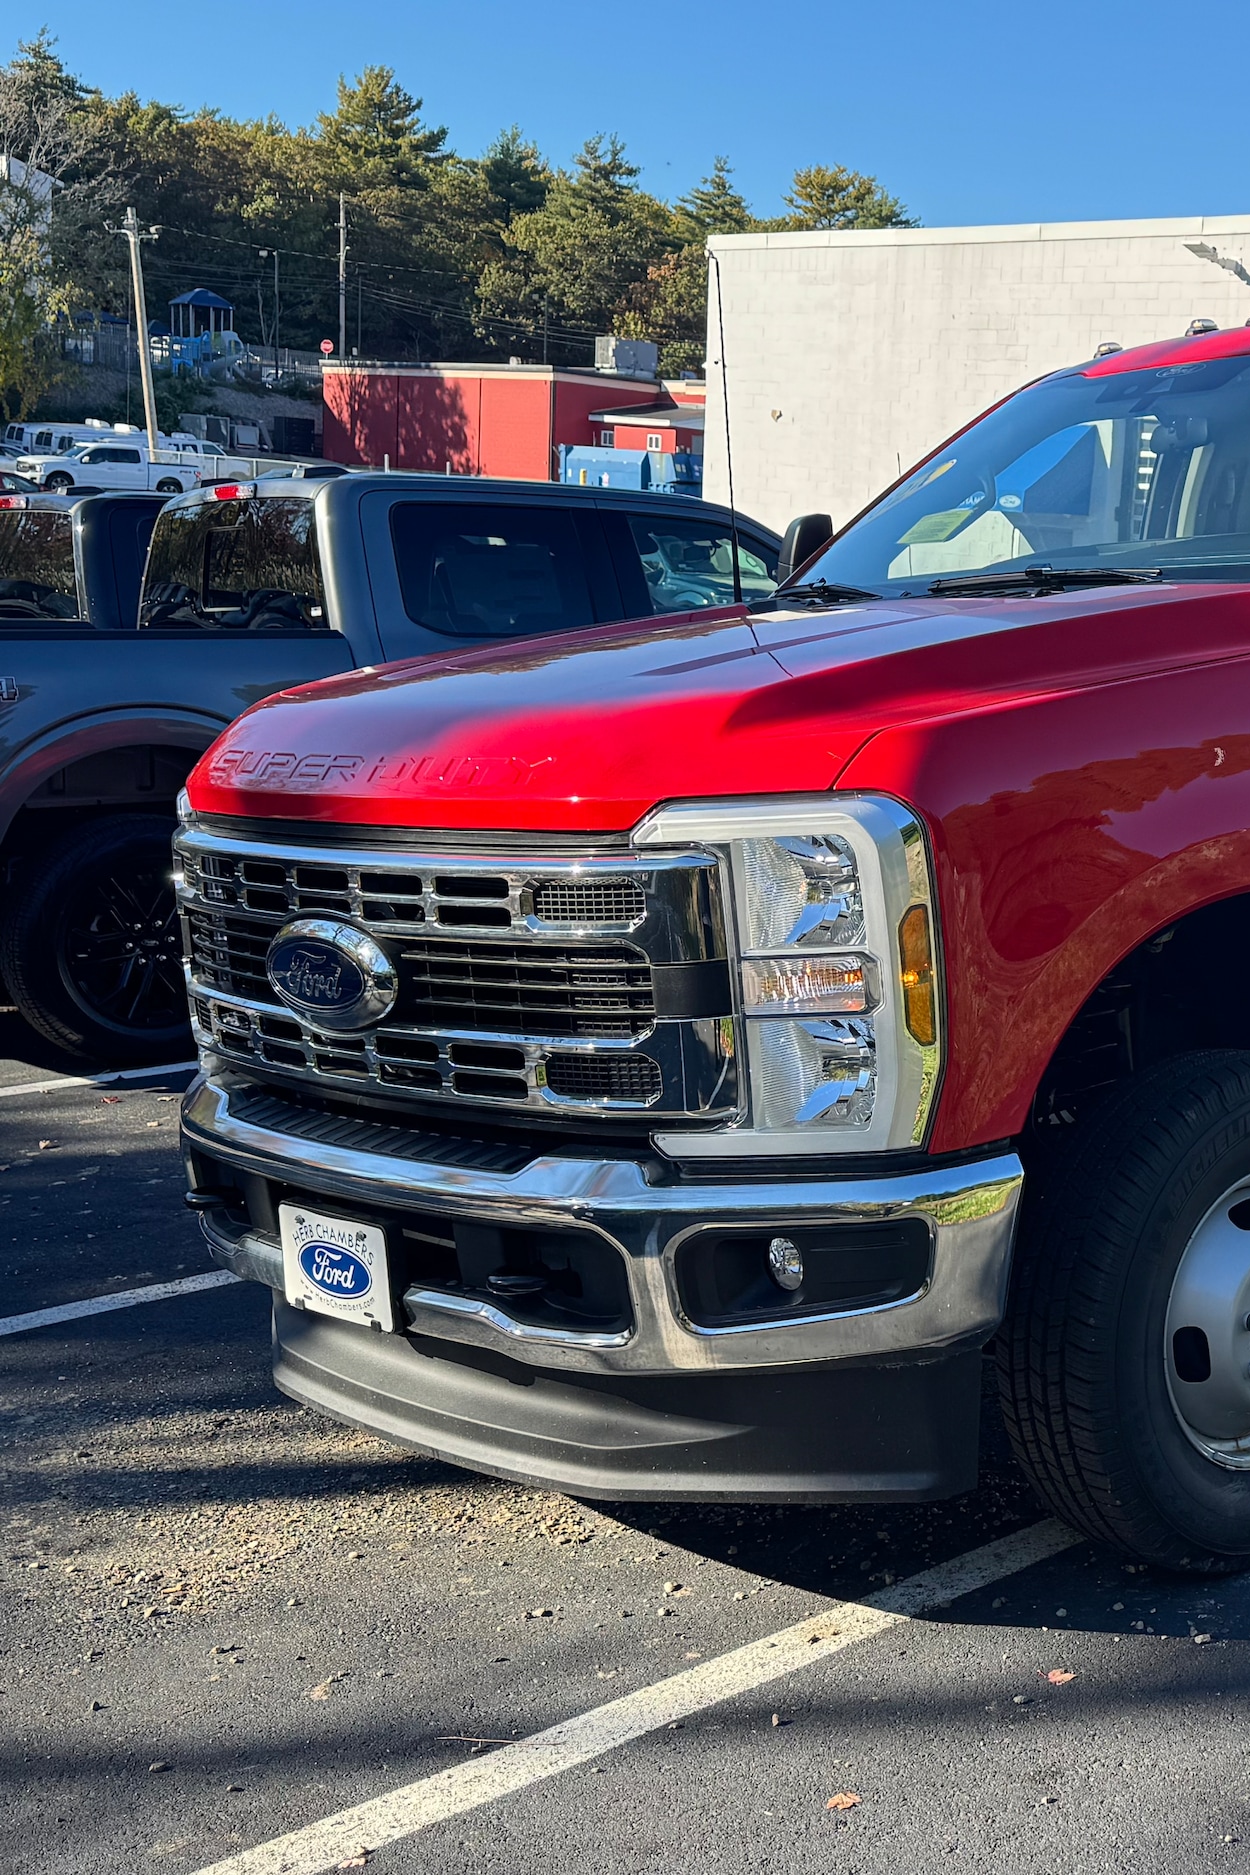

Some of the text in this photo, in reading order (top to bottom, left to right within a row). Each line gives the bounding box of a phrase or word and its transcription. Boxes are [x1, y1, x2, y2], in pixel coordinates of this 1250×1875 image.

[209, 749, 557, 786] SUPER DUTY
[286, 949, 343, 1000] Ford
[292, 1223, 375, 1266] HERB CHAMBERS
[312, 1248, 355, 1289] Ford
